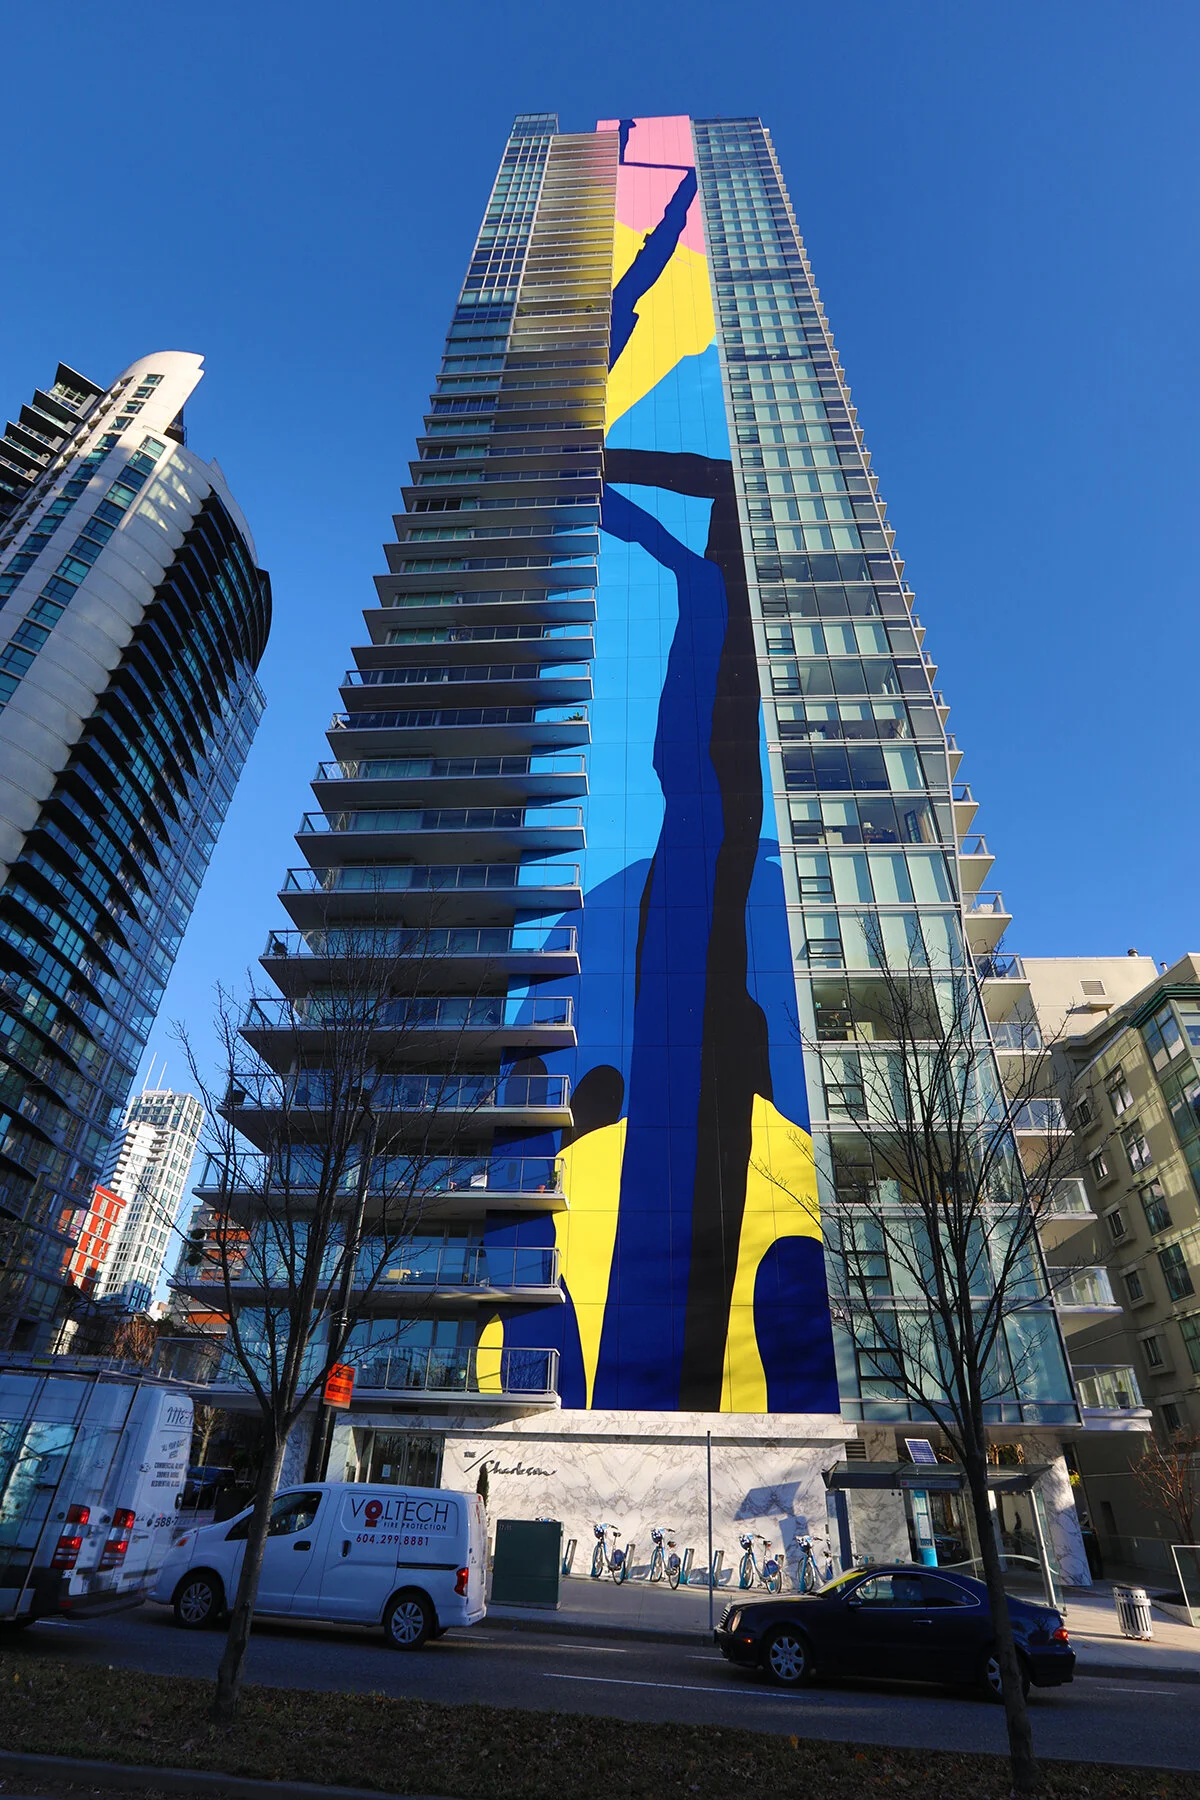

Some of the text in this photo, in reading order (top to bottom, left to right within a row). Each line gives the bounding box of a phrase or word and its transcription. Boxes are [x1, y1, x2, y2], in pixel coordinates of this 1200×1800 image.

[383, 1521, 447, 1531] FIRE PROTECTION
[356, 1533, 429, 1546] 604.299.8881
